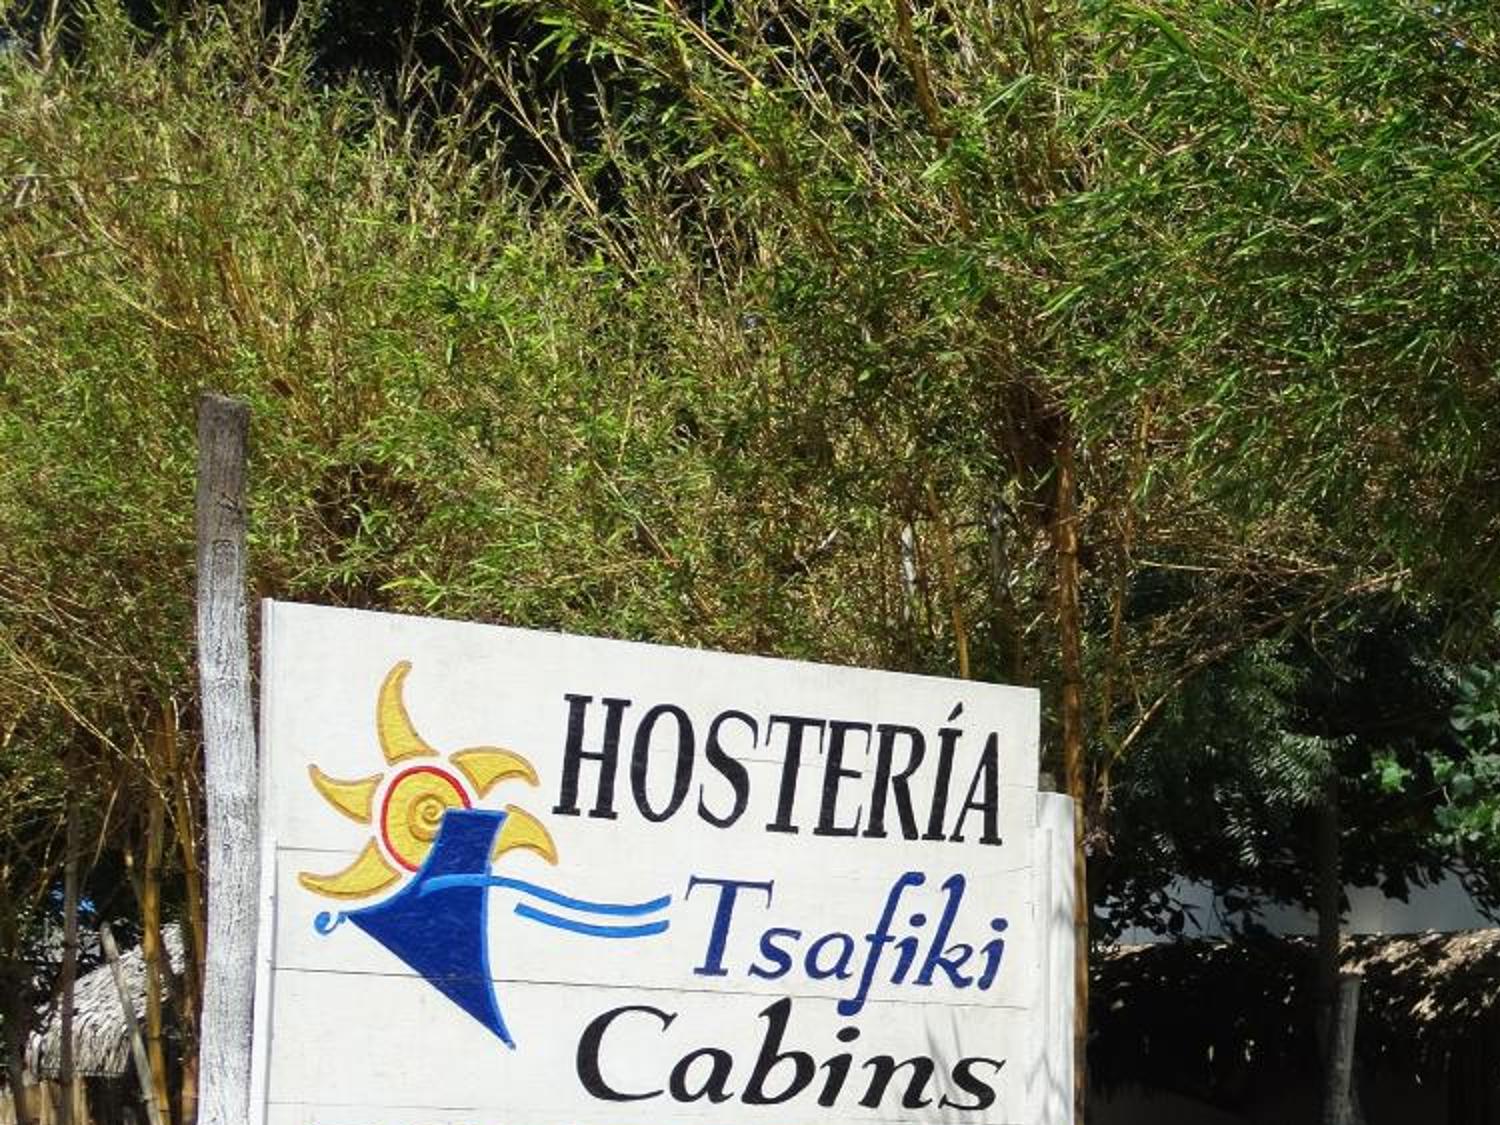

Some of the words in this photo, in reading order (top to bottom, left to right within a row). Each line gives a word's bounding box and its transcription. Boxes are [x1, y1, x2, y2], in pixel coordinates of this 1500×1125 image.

[552, 692, 1003, 847] HOSTERÍA
[684, 872, 1009, 1016] Tsafiki
[575, 997, 1006, 1112] Cabins
